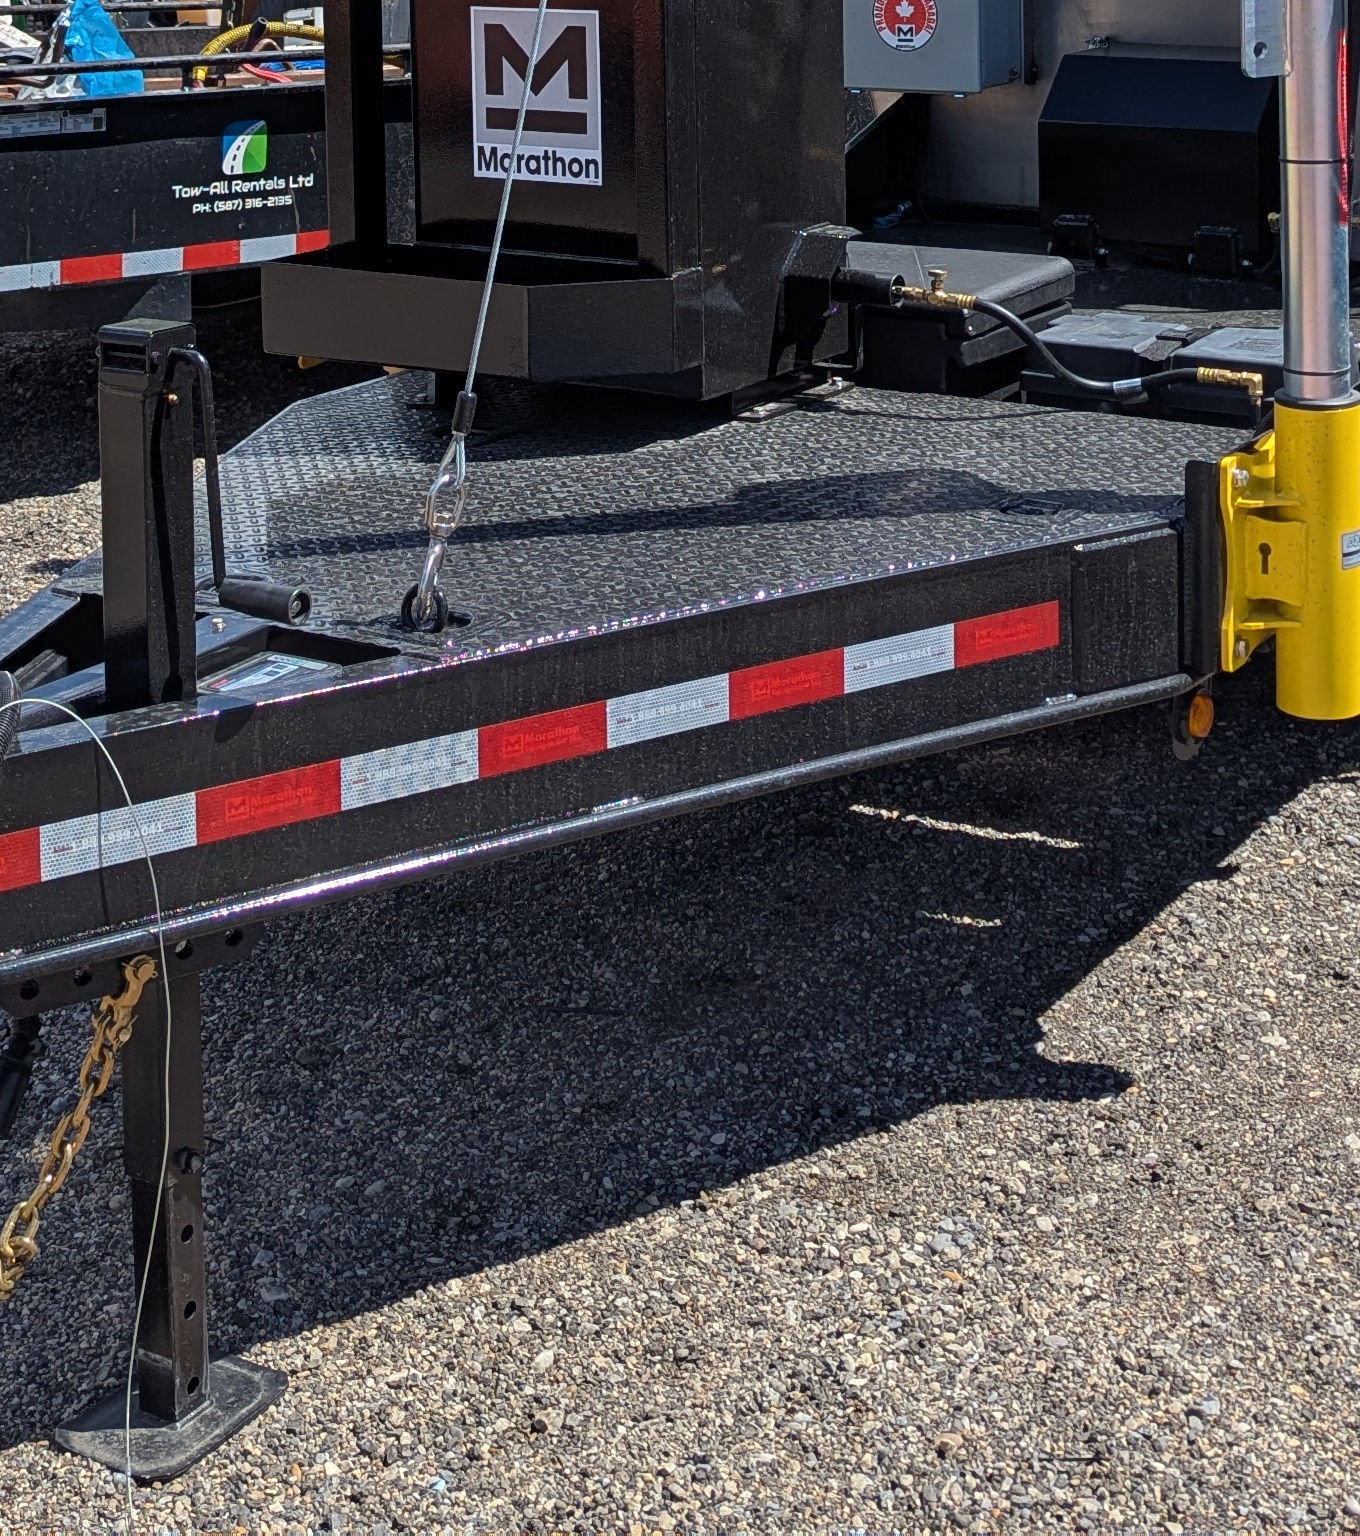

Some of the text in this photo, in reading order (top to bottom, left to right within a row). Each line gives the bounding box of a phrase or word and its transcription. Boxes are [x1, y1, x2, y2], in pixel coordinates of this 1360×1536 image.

[897, 26, 914, 38] M
[484, 23, 588, 100] M
[477, 145, 600, 180] Marathon
[172, 172, 314, 199] Tow-All Rentals Ltd
[192, 194, 293, 215] PH: (587) 316-2135
[524, 725, 580, 744] Marathon
[250, 786, 313, 807] Marathon
